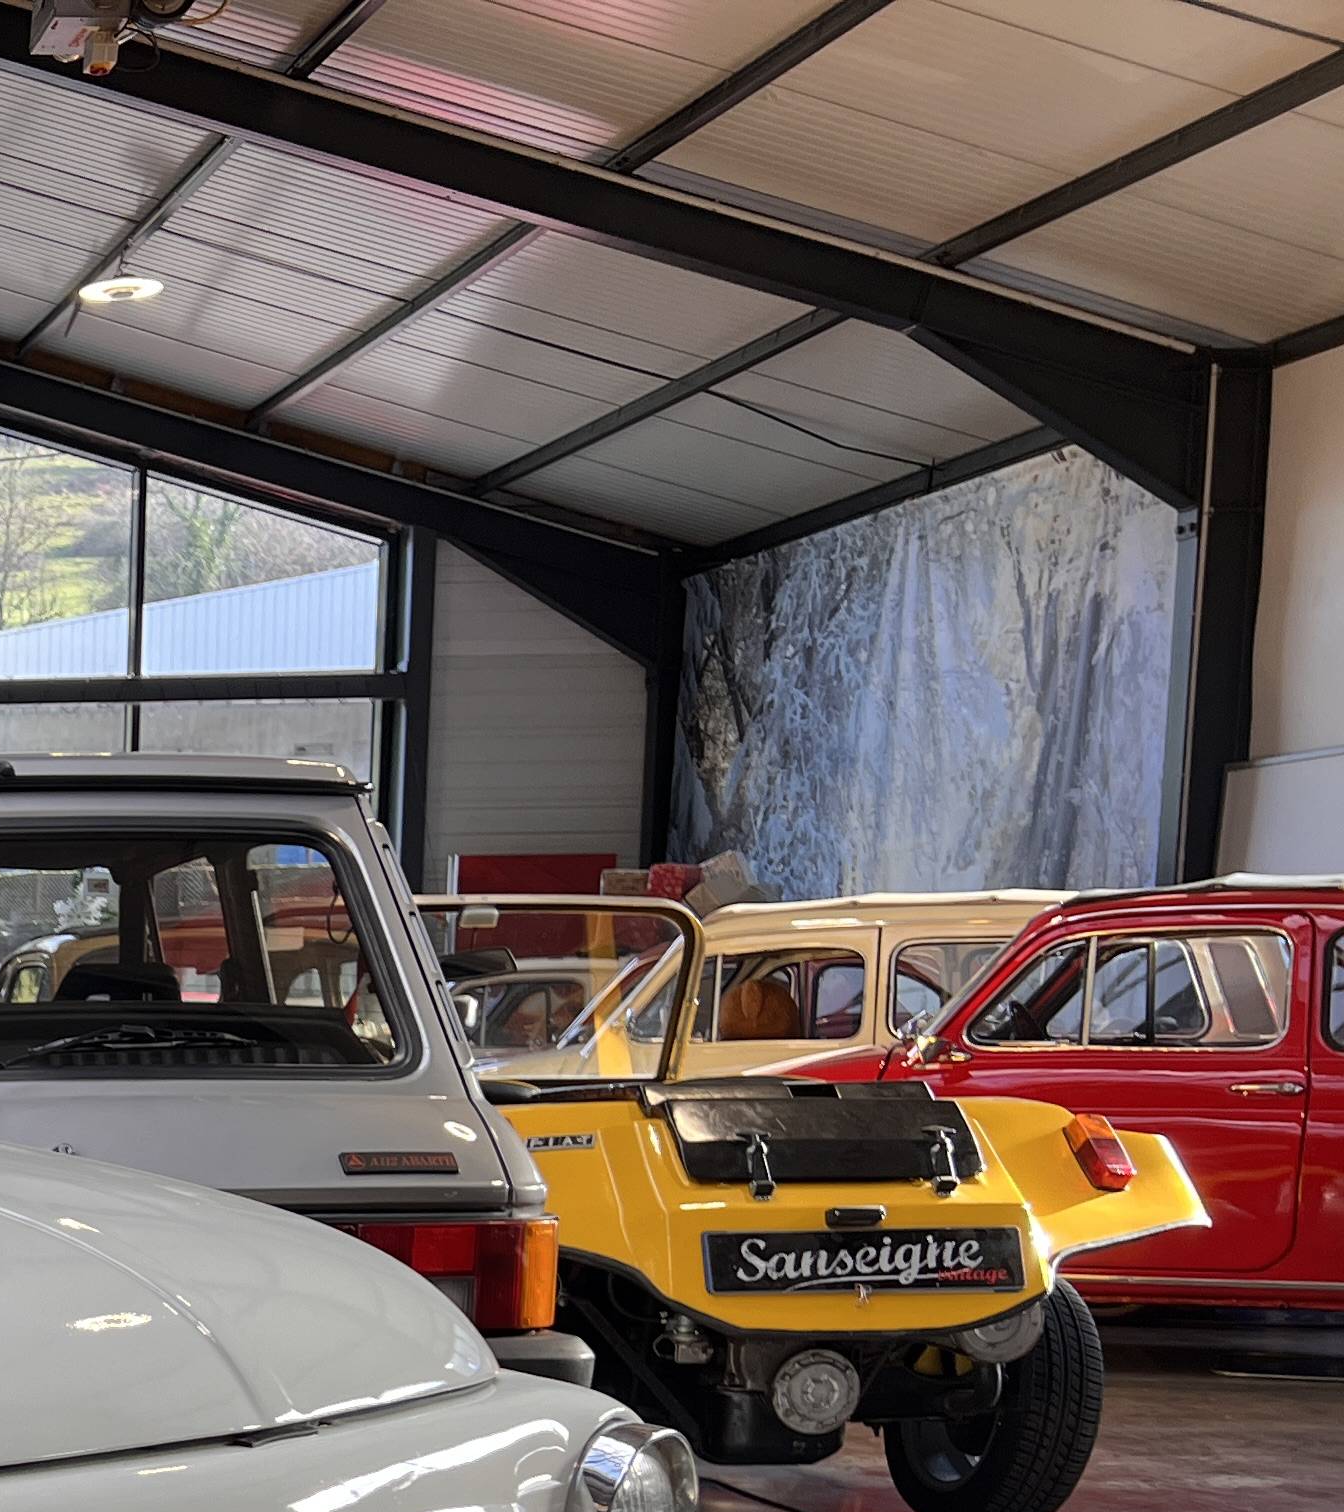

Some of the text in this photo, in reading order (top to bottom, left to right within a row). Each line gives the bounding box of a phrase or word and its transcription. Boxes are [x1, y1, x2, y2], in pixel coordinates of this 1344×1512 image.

[529, 1135, 593, 1148] FIAT
[400, 1155, 455, 1167] ABARTH
[736, 1234, 984, 1285] Sanseigne
